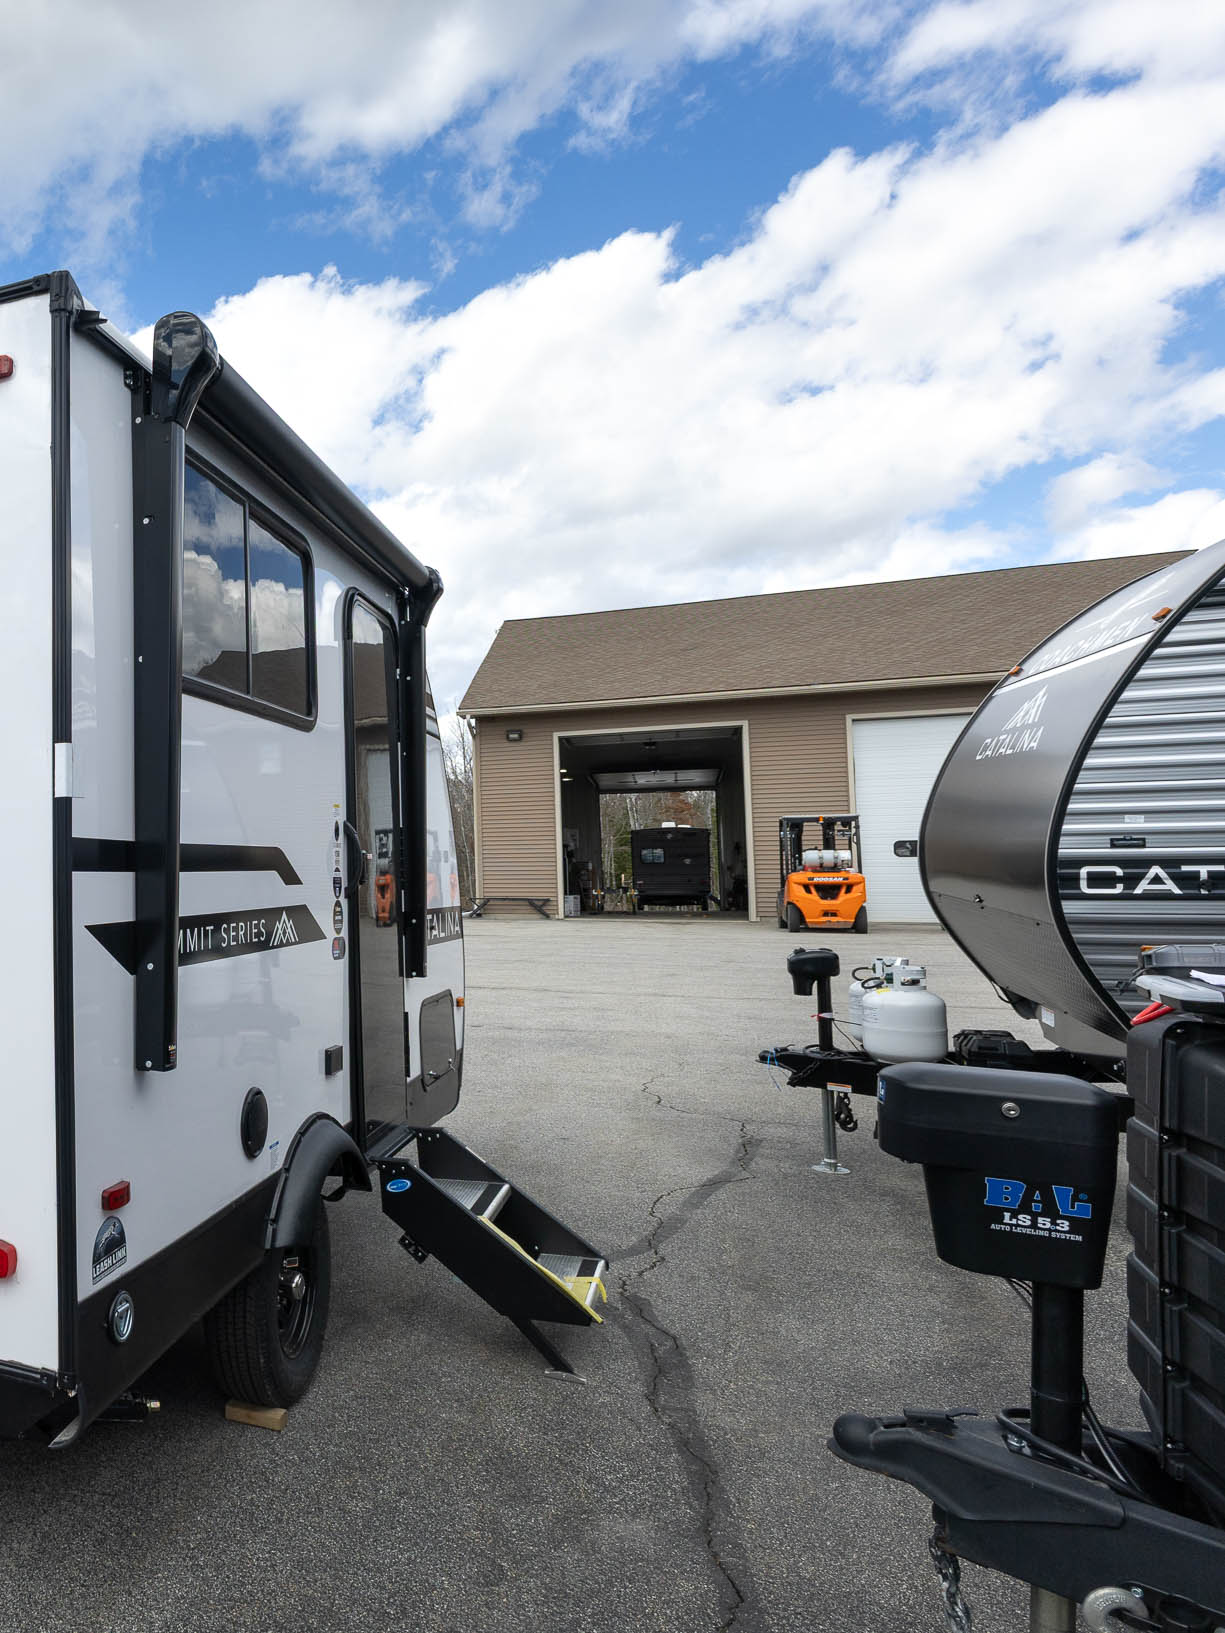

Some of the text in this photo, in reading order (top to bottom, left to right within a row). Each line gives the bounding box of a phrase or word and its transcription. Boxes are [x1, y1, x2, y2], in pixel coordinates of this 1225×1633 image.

[976, 726, 1045, 760] CATALINA
[1079, 865, 1225, 894] CAT
[221, 919, 266, 948] SERIES
[983, 1176, 1092, 1219] BAL
[990, 1223, 1083, 1242] AUTO LEVELING SYSTEM
[1003, 1211, 1070, 1231] LS 5.3
[93, 1246, 126, 1278] LEASH LINK
